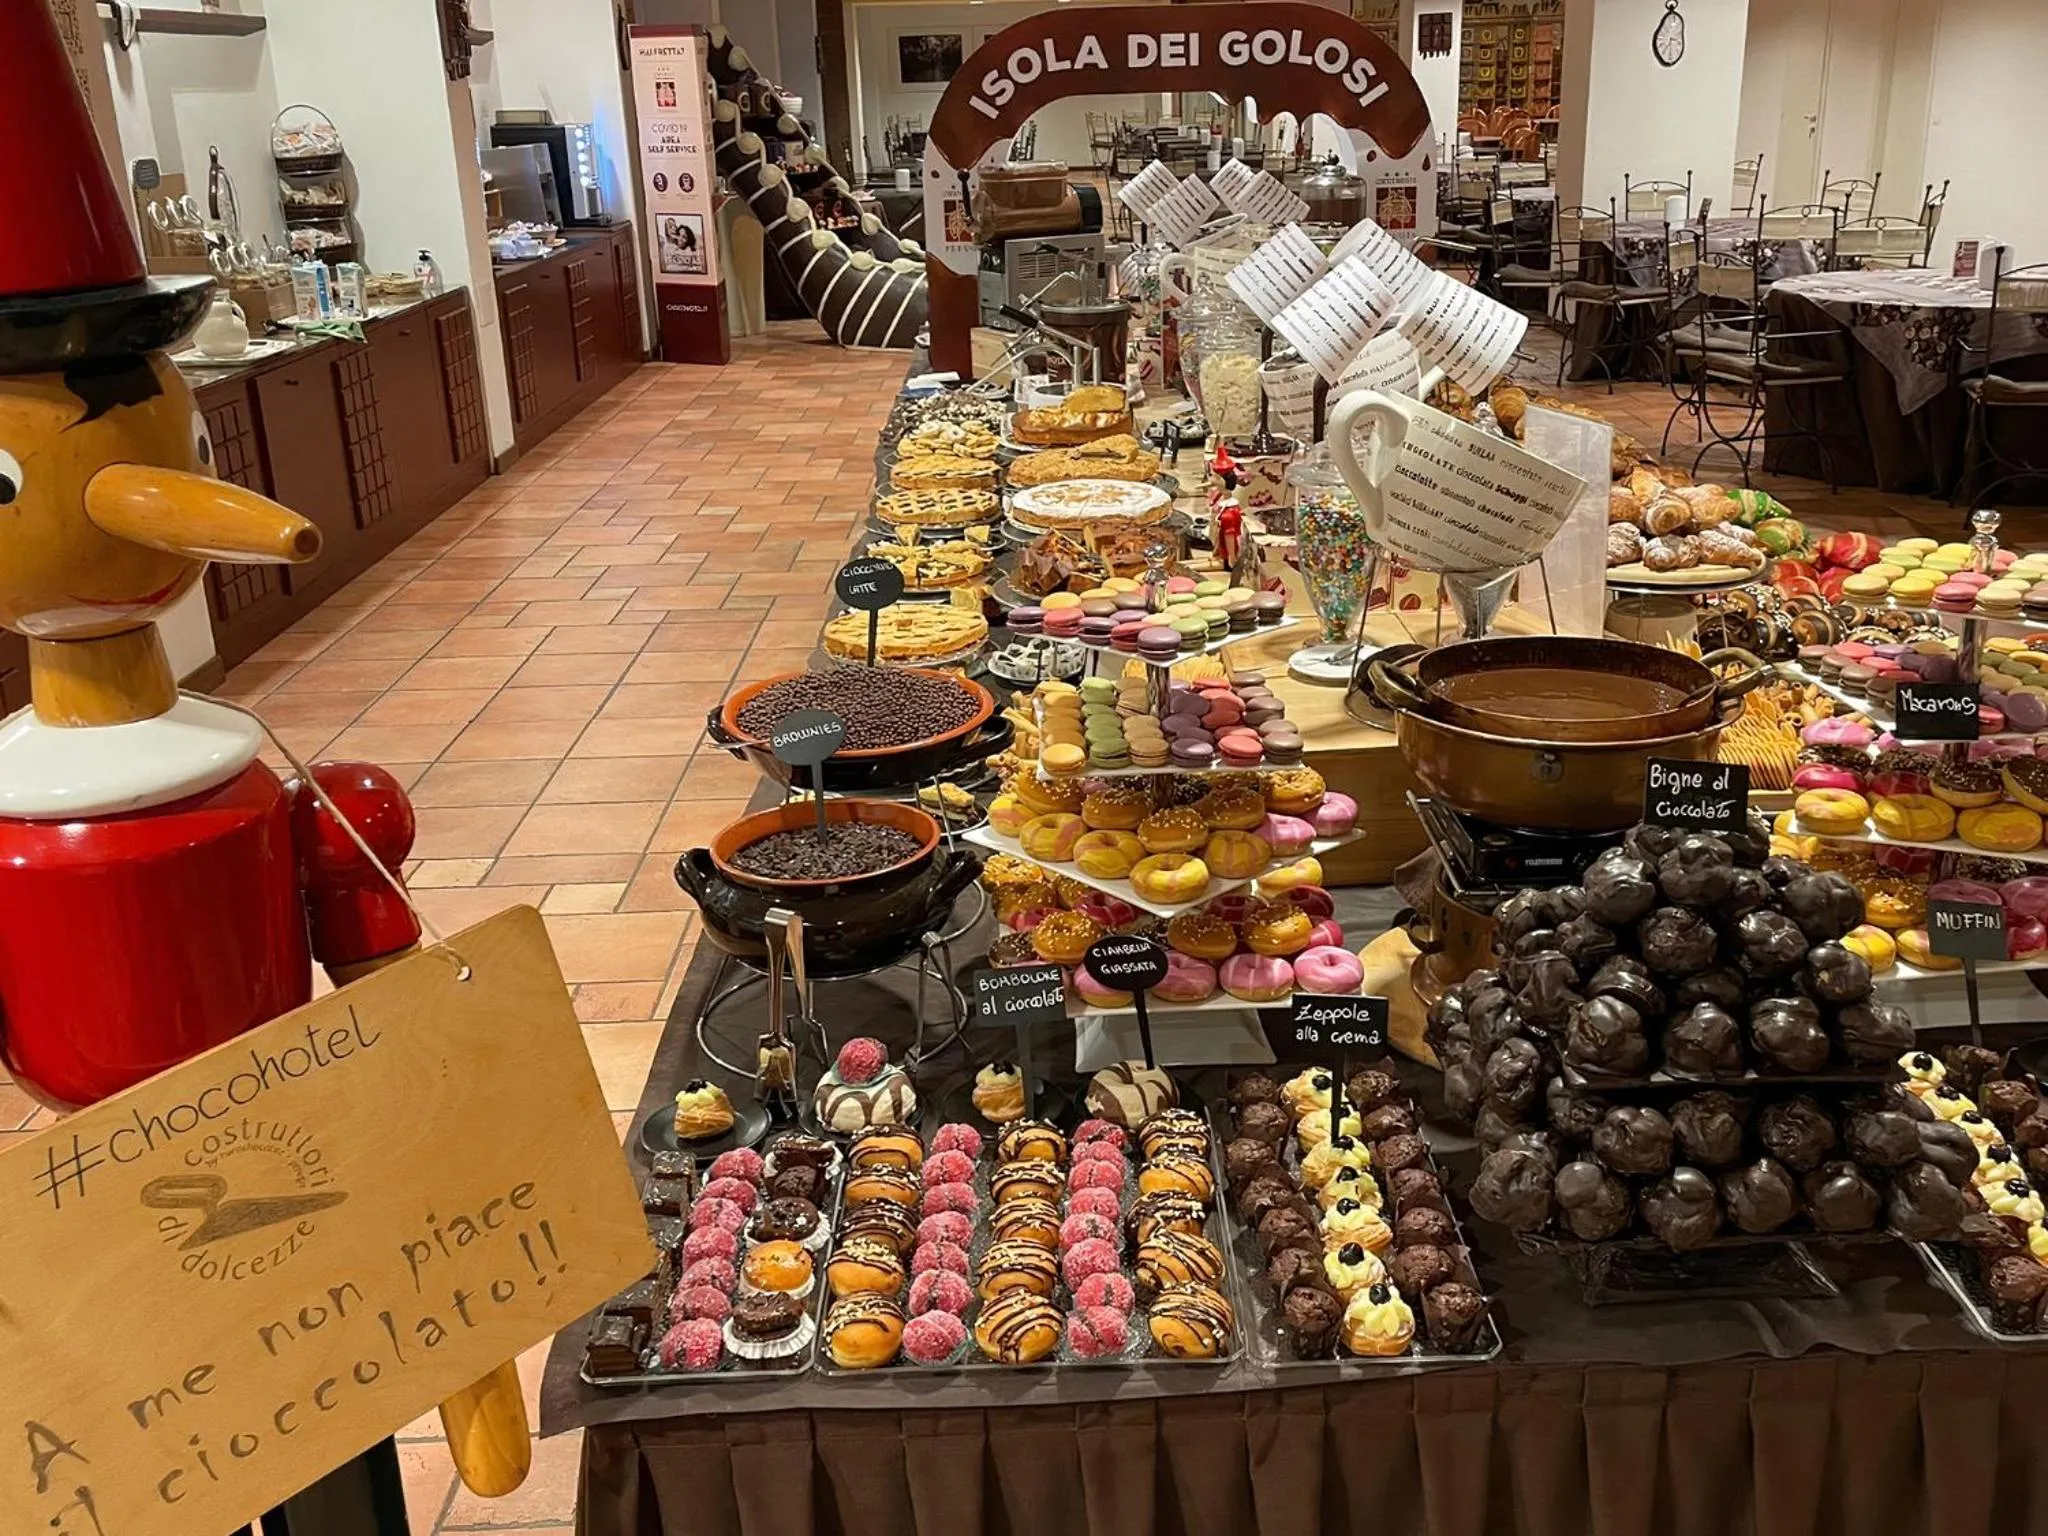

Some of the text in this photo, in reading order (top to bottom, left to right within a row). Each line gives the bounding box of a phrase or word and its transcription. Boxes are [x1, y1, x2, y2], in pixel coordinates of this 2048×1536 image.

[969, 29, 1390, 120] ISOLA DEI GOLOSI
[848, 582, 878, 595] LATTE
[1900, 688, 1977, 715] Macarons
[773, 721, 842, 748] BROWNIES
[1650, 764, 1730, 795] Bigne al
[1936, 911, 2001, 930] MUFFIN
[1092, 943, 1151, 957] CIAMBELLA
[1101, 961, 1157, 975] GLASSATA
[979, 969, 1061, 991] BOMBOLONE
[982, 995, 998, 1016] al
[1294, 1003, 1370, 1026] Zeppole
[1296, 1025, 1319, 1042] alla
[33, 1004, 380, 1210] #chocohotel
[181, 1220, 315, 1281] dolcezze
[25, 1181, 537, 1493] A me non piace
